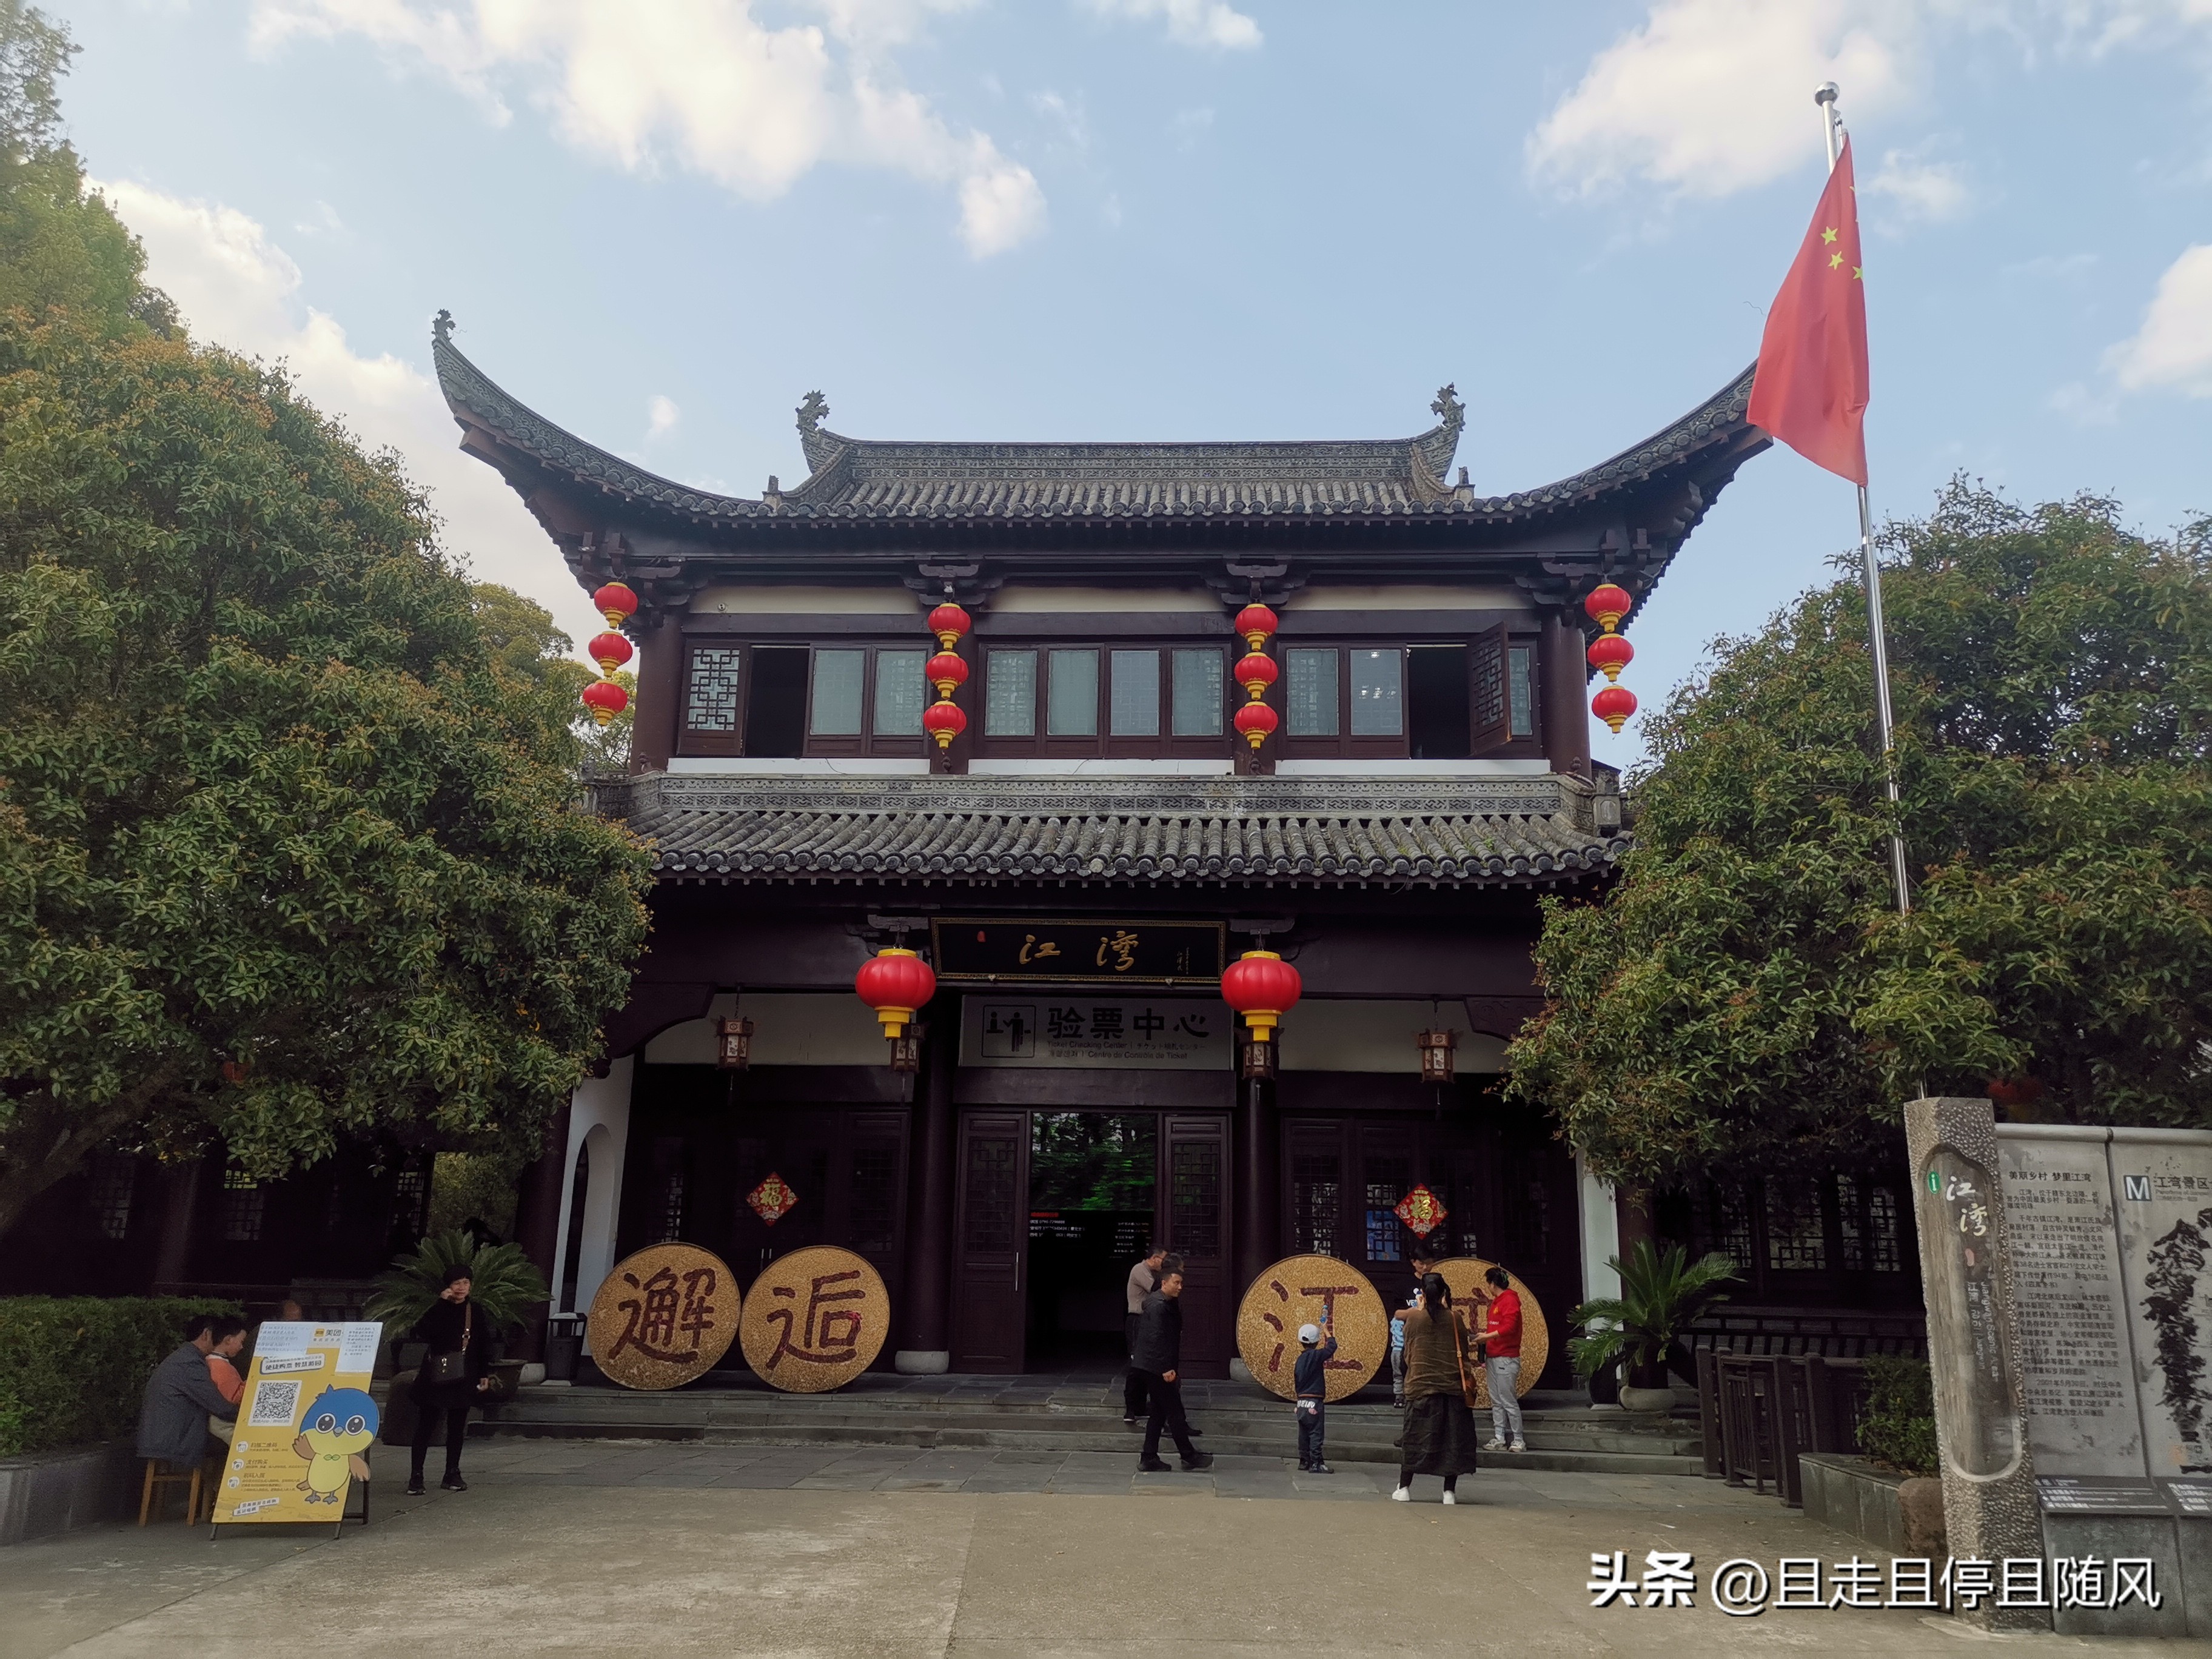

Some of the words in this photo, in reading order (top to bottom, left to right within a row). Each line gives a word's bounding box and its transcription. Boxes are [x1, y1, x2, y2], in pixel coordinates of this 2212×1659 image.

[1048, 1007, 1210, 1040] 验票中心
[1069, 1041, 1101, 1050] Checking
[2009, 1171, 2047, 1180] 美丽乡村
[2052, 1172, 2091, 1182] 梦里江湾
[2126, 1176, 2150, 1199] M
[1409, 1195, 1433, 1220] 福
[325, 1329, 342, 1337] 美团
